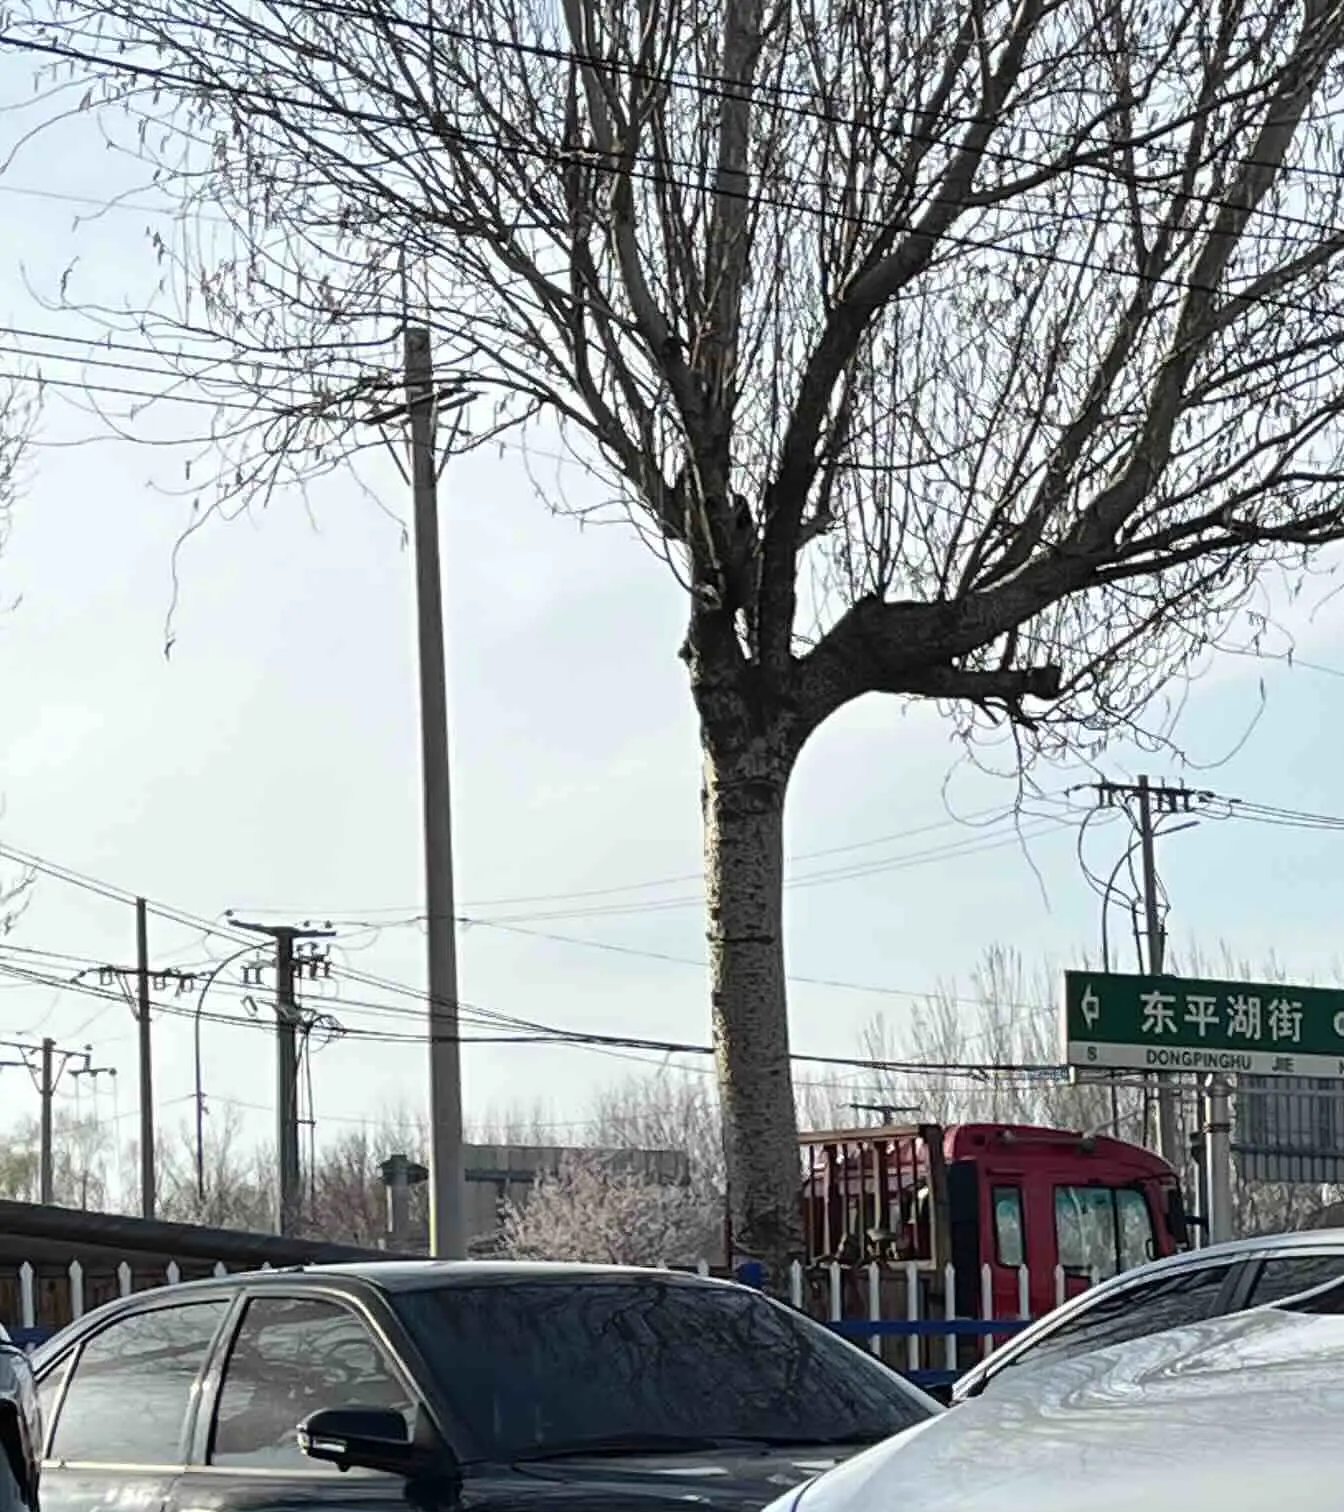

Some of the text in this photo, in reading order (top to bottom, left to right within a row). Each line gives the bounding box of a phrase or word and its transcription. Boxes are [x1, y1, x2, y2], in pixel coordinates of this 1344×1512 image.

[1139, 989, 1304, 1043] 东平湖街
[1146, 1048, 1252, 1072] DONGPINGHU
[1272, 1056, 1295, 1073] JIE
